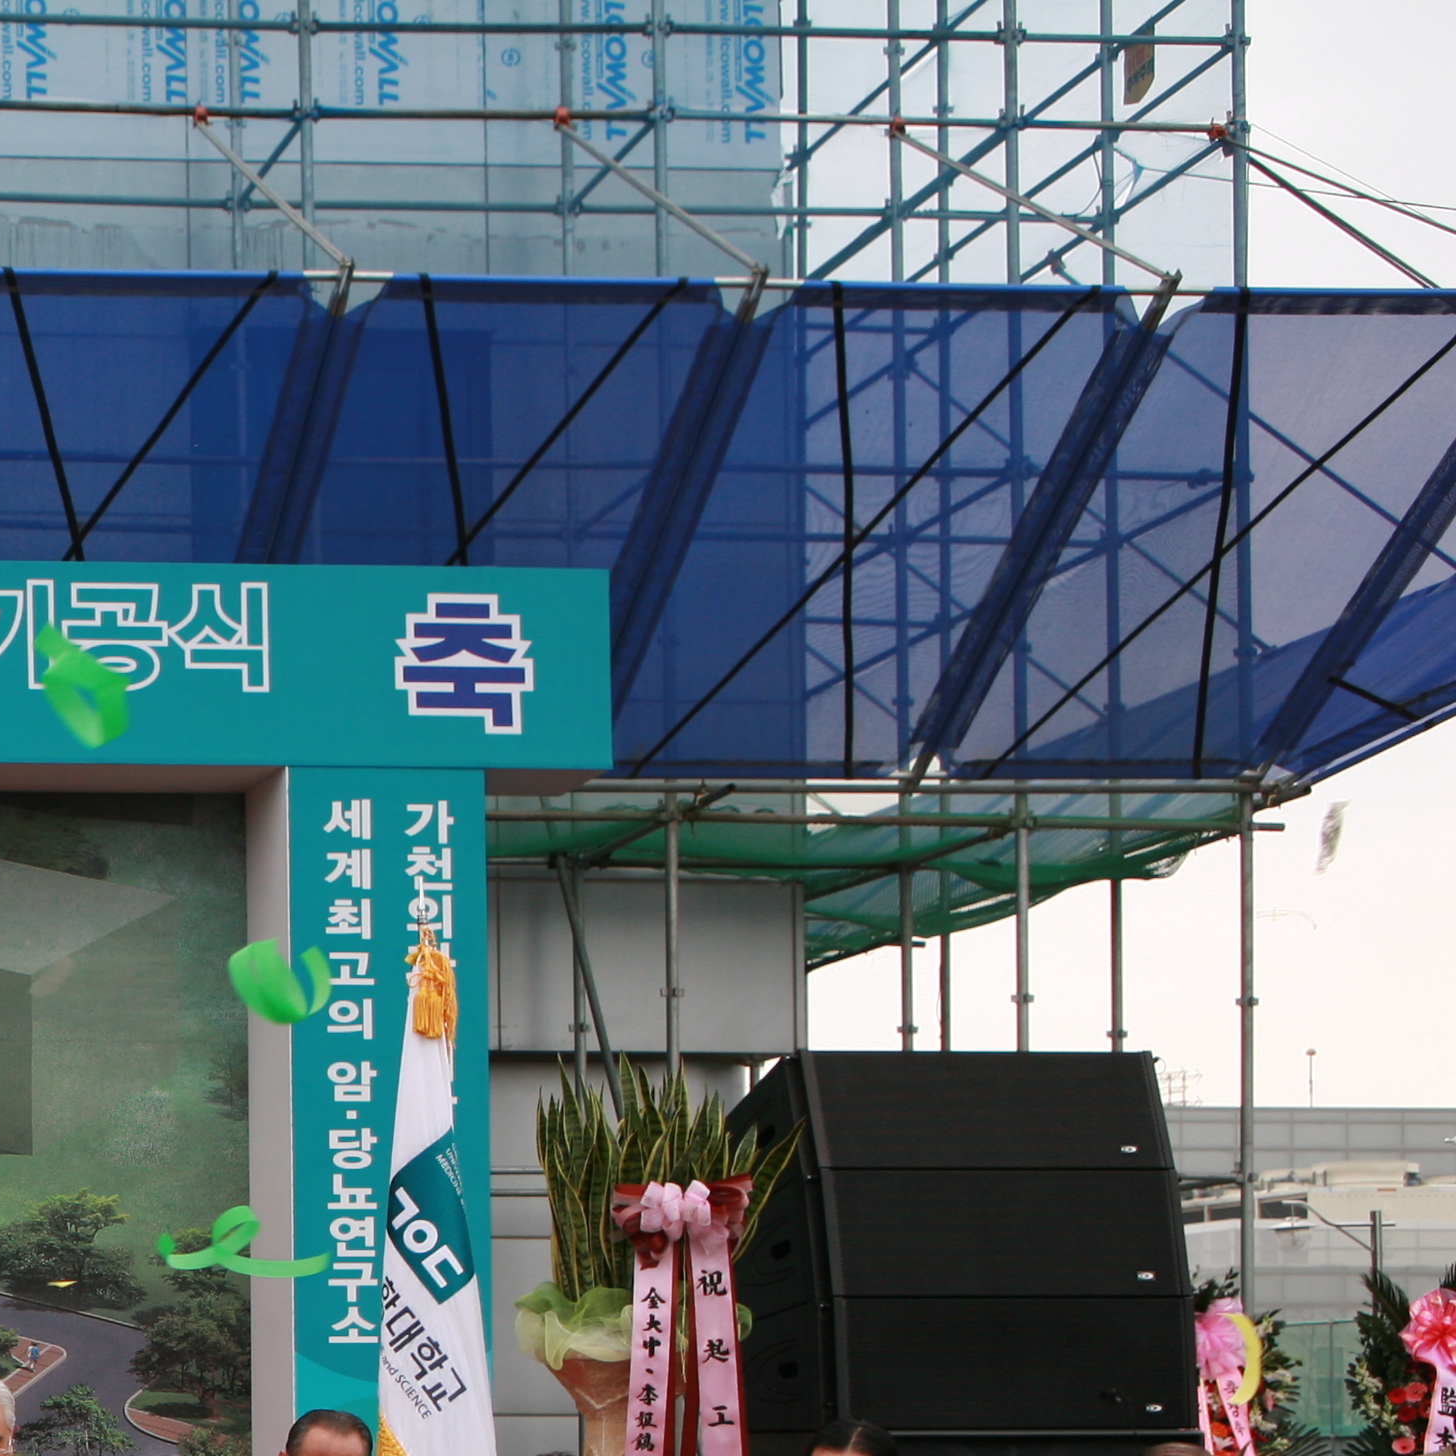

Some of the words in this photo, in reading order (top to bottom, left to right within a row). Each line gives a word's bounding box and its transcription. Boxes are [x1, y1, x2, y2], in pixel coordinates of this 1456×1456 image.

[394, 593, 534, 735] 축
[324, 798, 375, 1041] 세계최고의
[395, 1372, 432, 1420] SCIENCE
